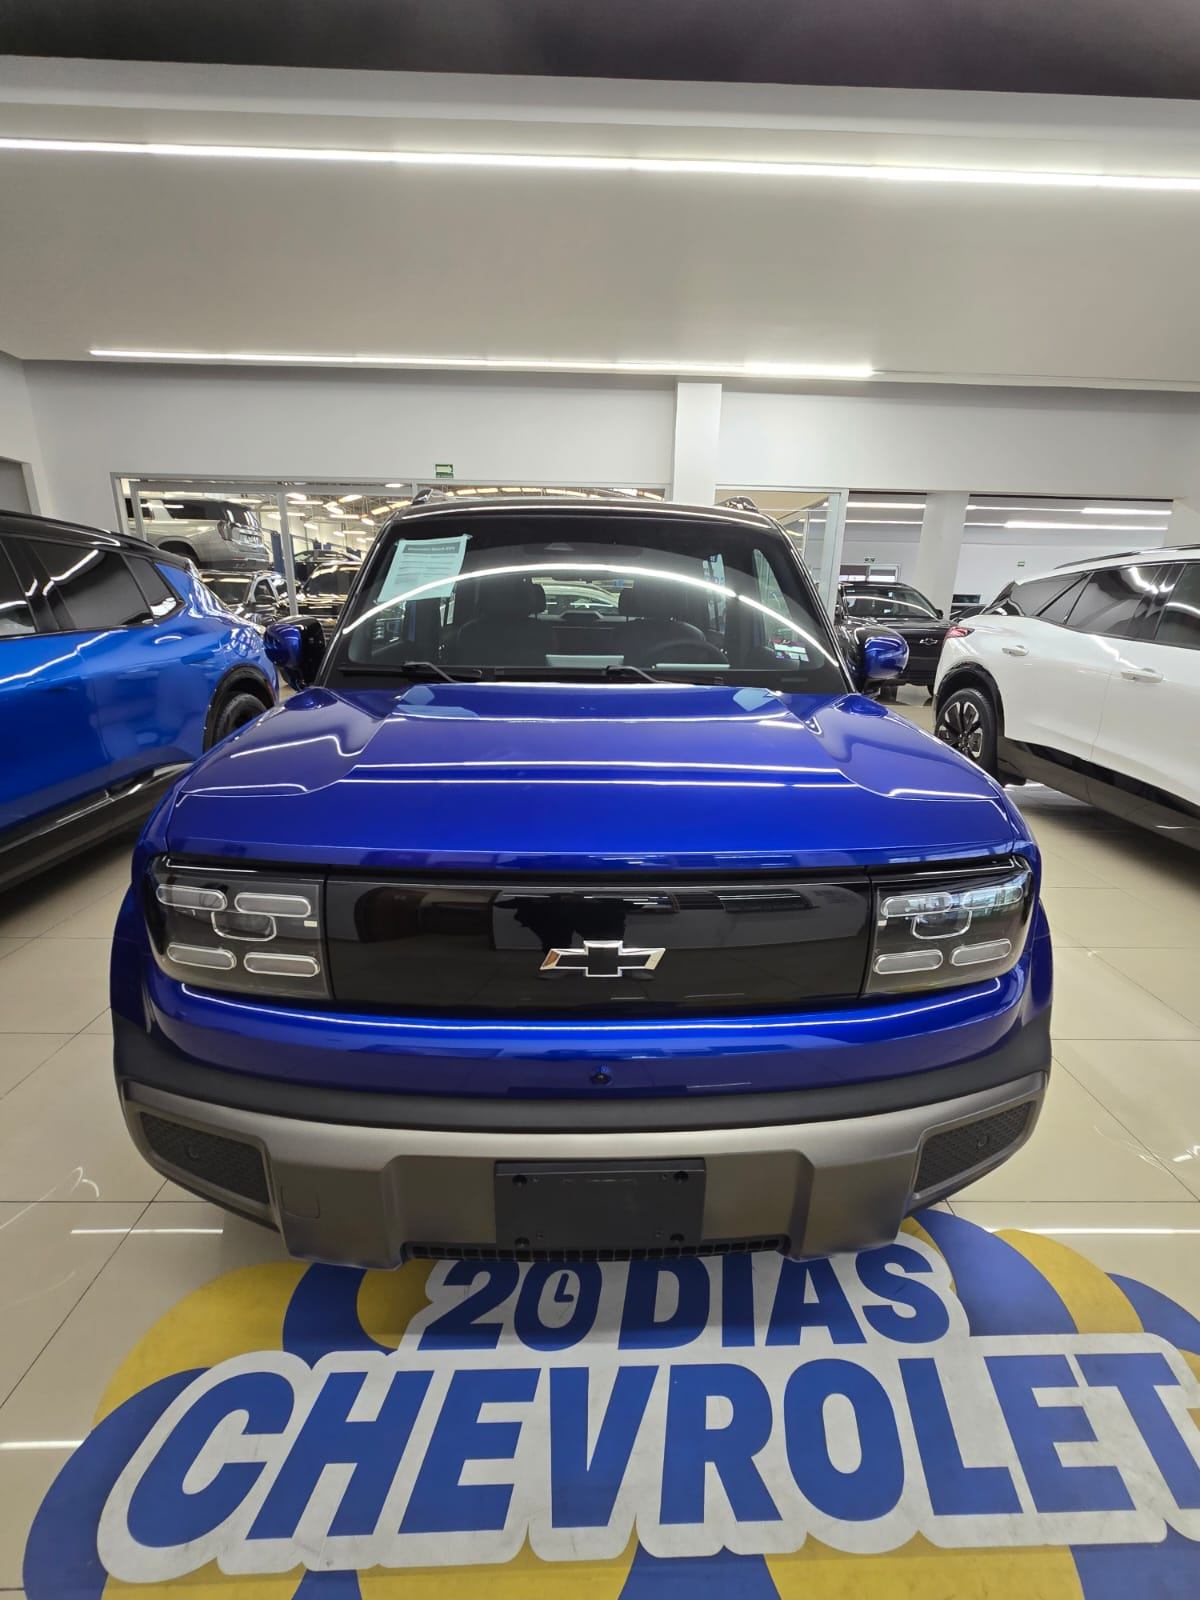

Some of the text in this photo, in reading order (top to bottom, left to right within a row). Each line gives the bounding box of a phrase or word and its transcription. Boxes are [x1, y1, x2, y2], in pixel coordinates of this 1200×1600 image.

[417, 1240, 951, 1352] 20 DIAS
[126, 1352, 1200, 1548] CHEVROLET
